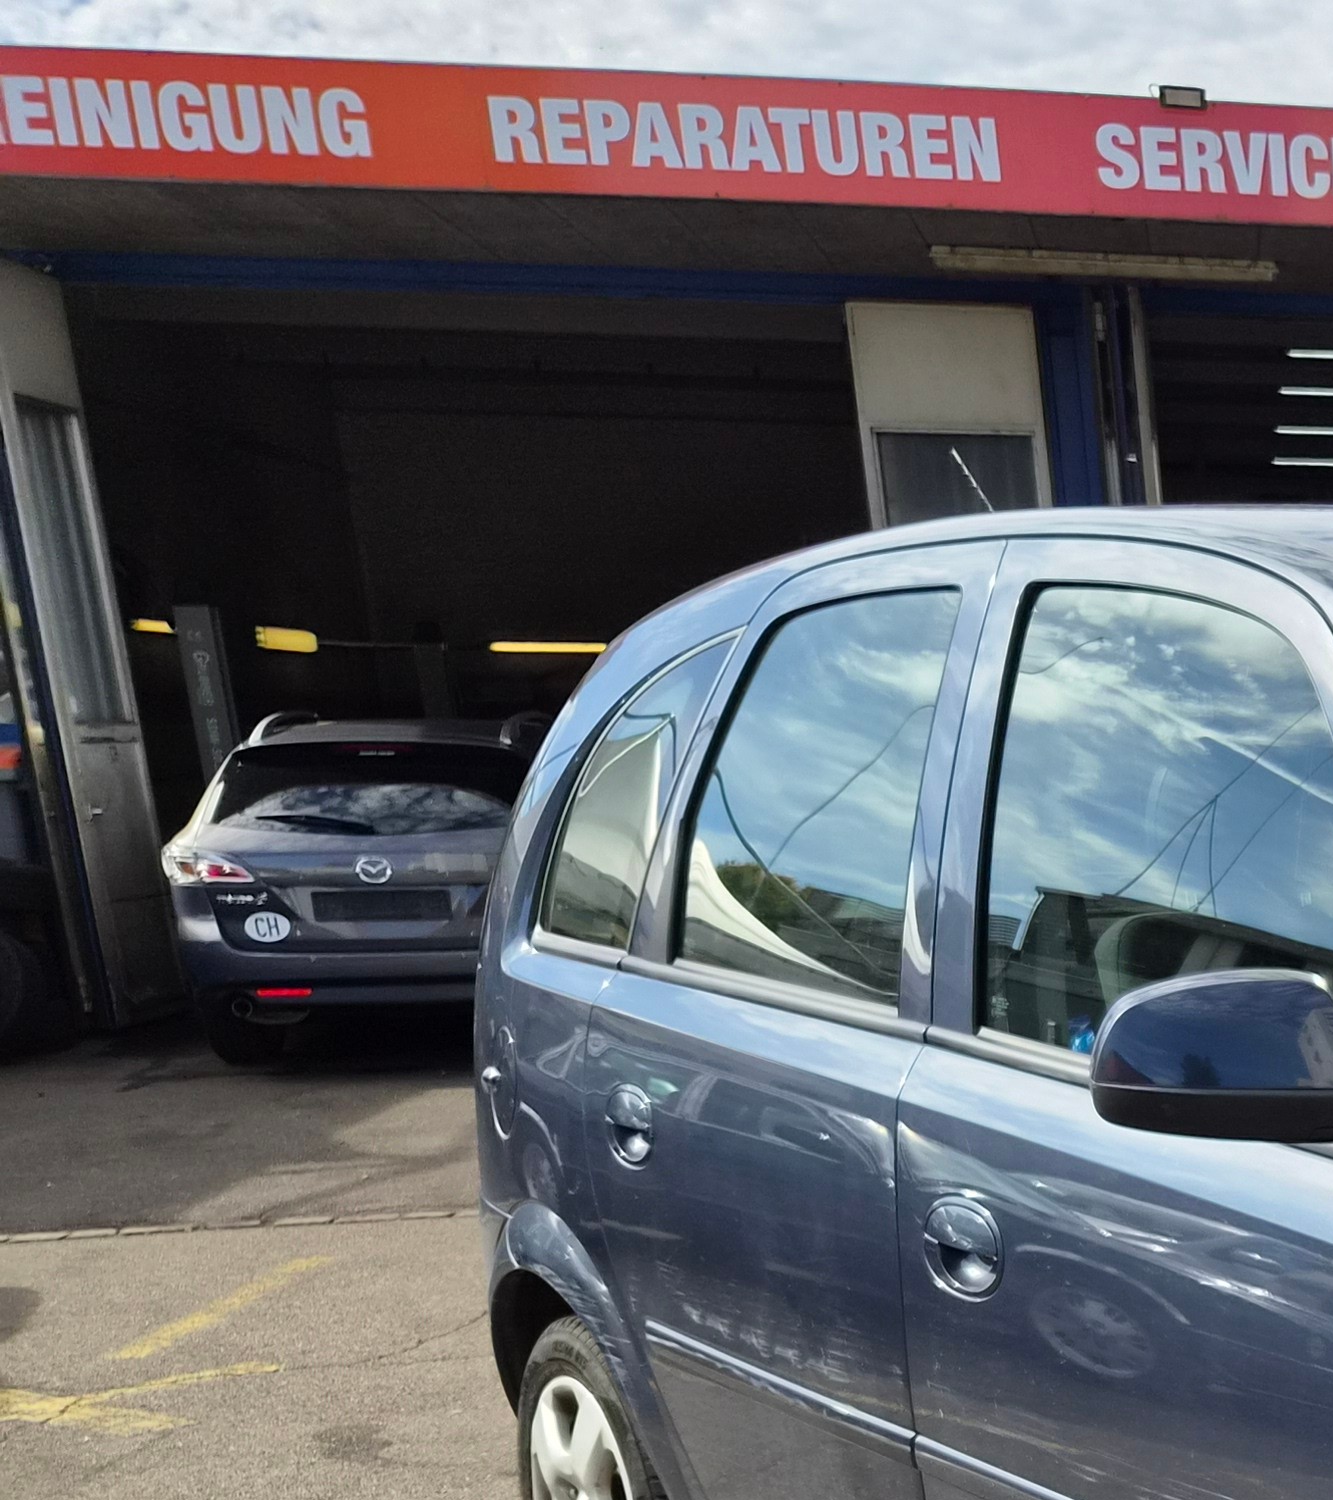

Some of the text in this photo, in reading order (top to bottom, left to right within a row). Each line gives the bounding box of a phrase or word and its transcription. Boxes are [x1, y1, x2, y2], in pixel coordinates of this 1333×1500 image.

[0, 75, 372, 157] EINIGUNG
[487, 96, 1002, 182] REPARATUREN
[254, 916, 281, 938] CH
